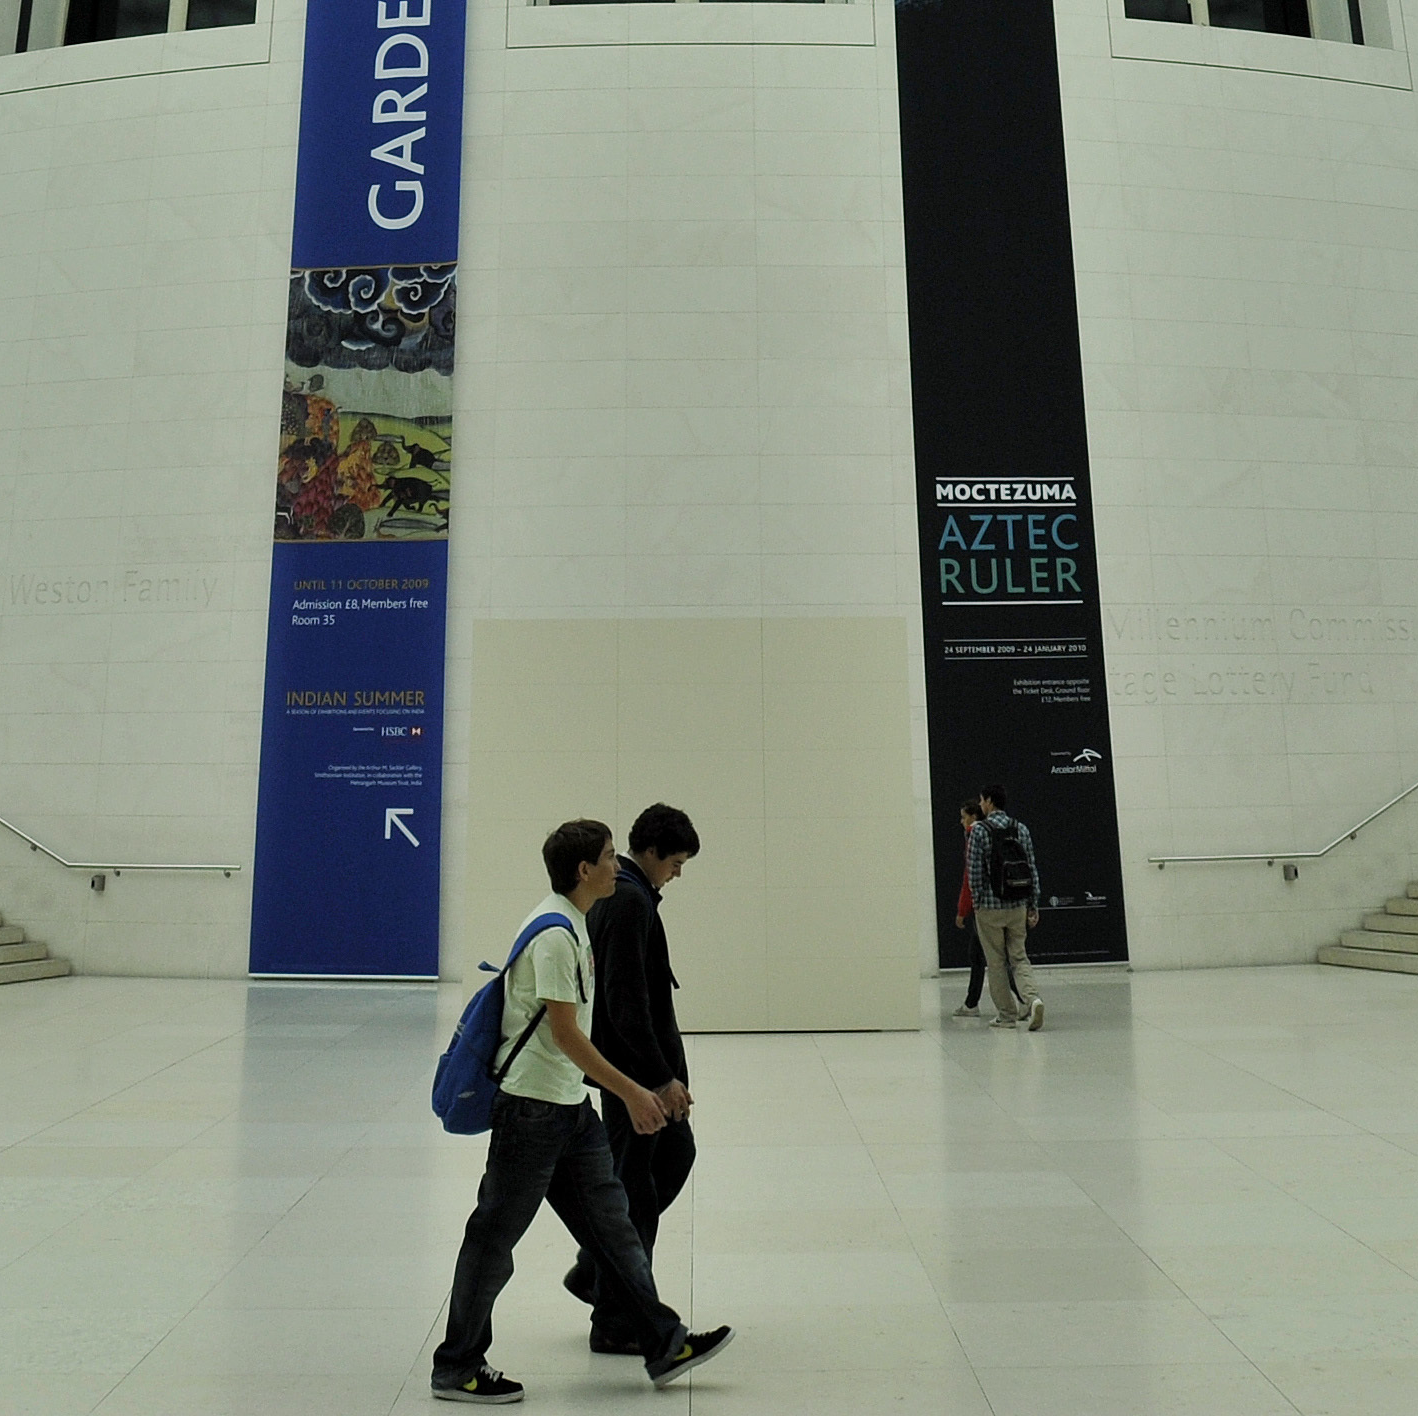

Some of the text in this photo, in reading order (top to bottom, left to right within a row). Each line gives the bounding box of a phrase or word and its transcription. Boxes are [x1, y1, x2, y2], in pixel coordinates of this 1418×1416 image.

[935, 482, 1077, 501] MOCTEZUMA
[938, 513, 1080, 551] AZTEC
[940, 557, 1082, 594] RULER
[293, 578, 430, 591] UNTIL 11 OCTOBER 2009
[292, 597, 429, 611] Admission £8, Members free
[291, 614, 336, 626] Room 35
[944, 645, 954, 655] 24
[955, 645, 996, 654] SEPTEMBER
[997, 645, 1015, 654] 2009
[1023, 644, 1033, 653] 24
[1034, 644, 1067, 654] JANUARY
[286, 690, 425, 707] INDIAN SUMMER
[381, 726, 408, 737] HSBC
